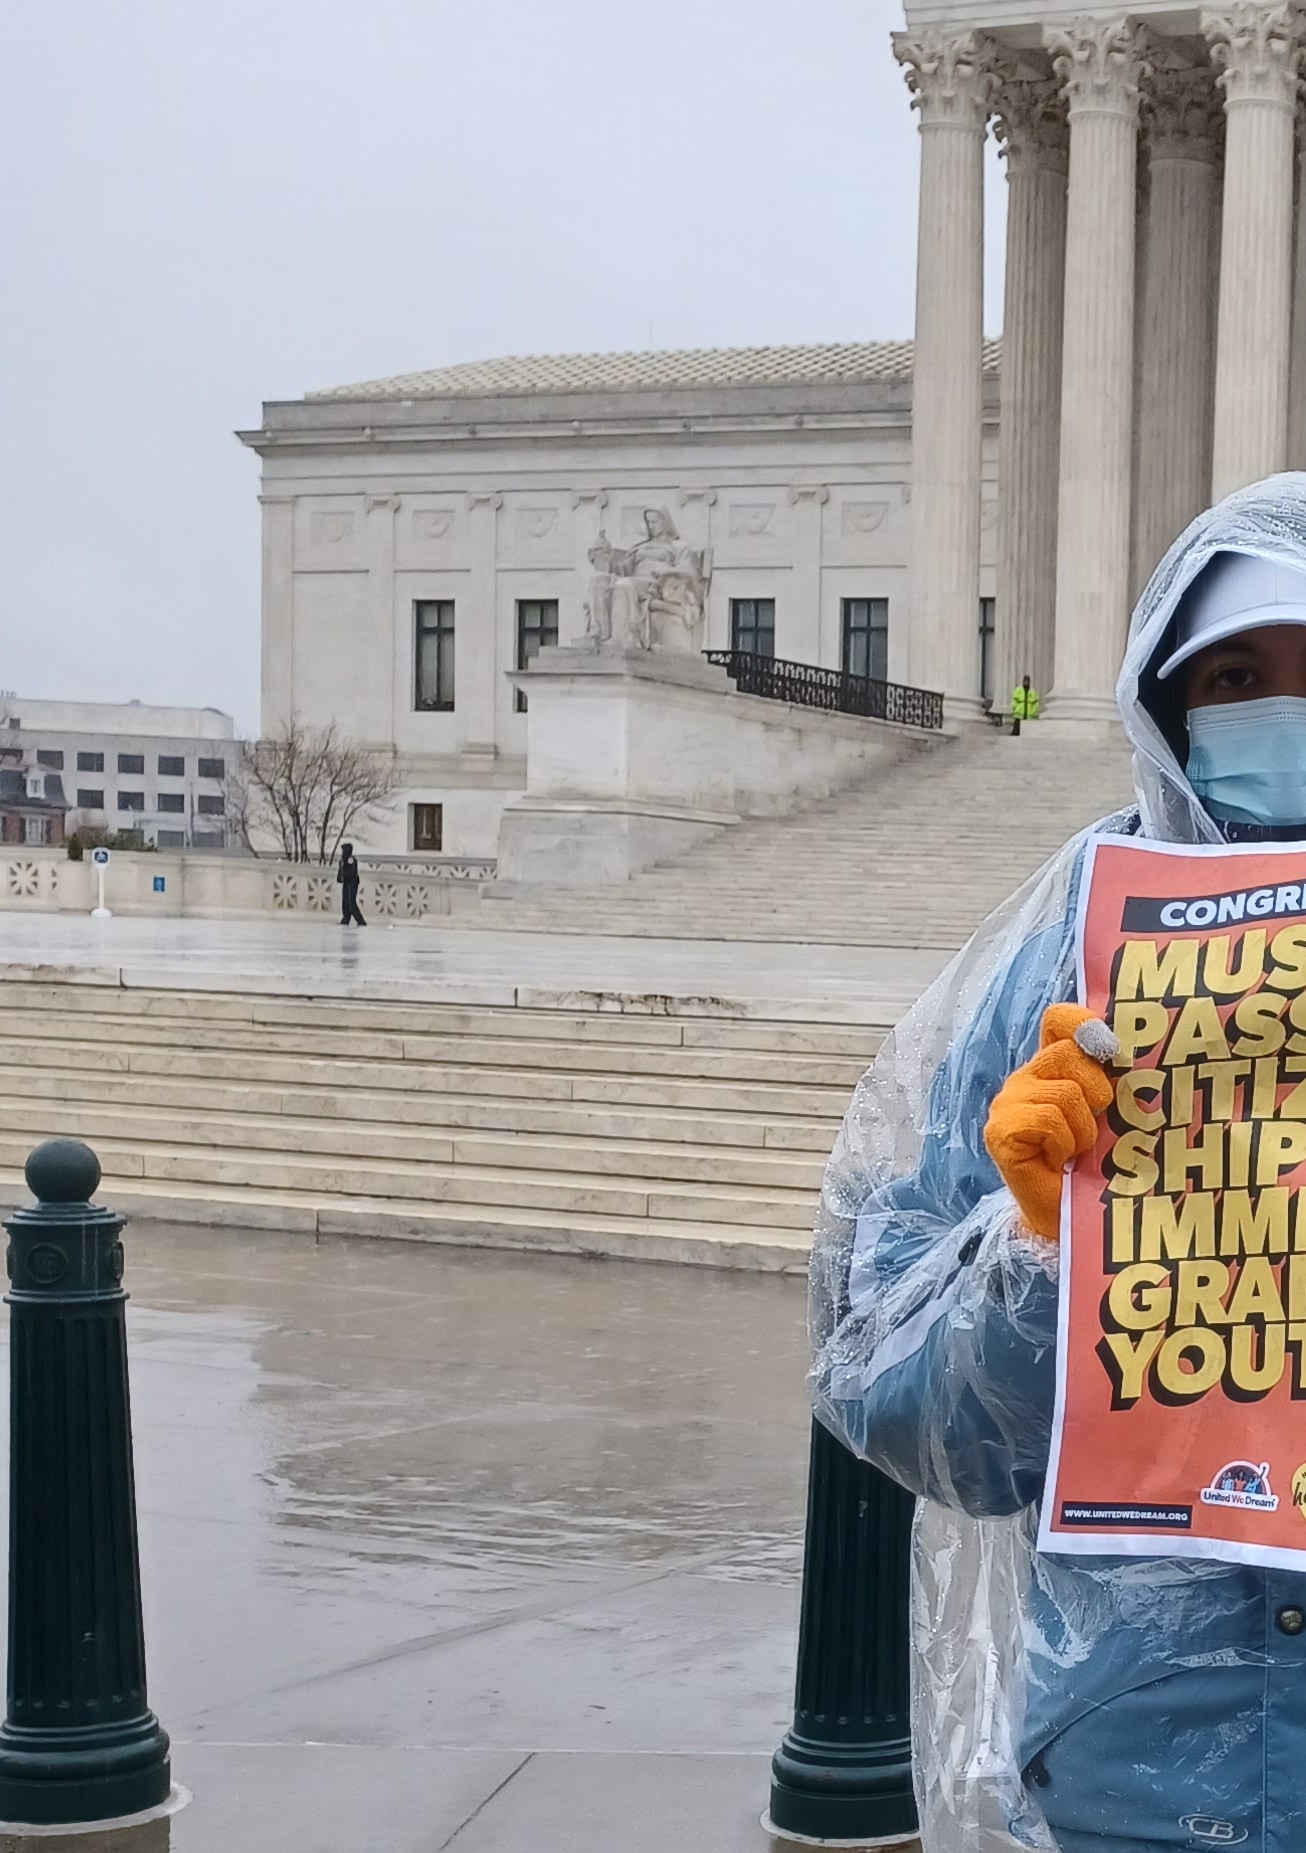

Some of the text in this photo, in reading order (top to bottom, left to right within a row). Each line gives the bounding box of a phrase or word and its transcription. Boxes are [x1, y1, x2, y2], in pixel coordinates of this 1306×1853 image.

[1203, 1491, 1275, 1508] United We Dream
[1064, 1509, 1188, 1521] WWW.UNITEDWEDREAM.ORG
